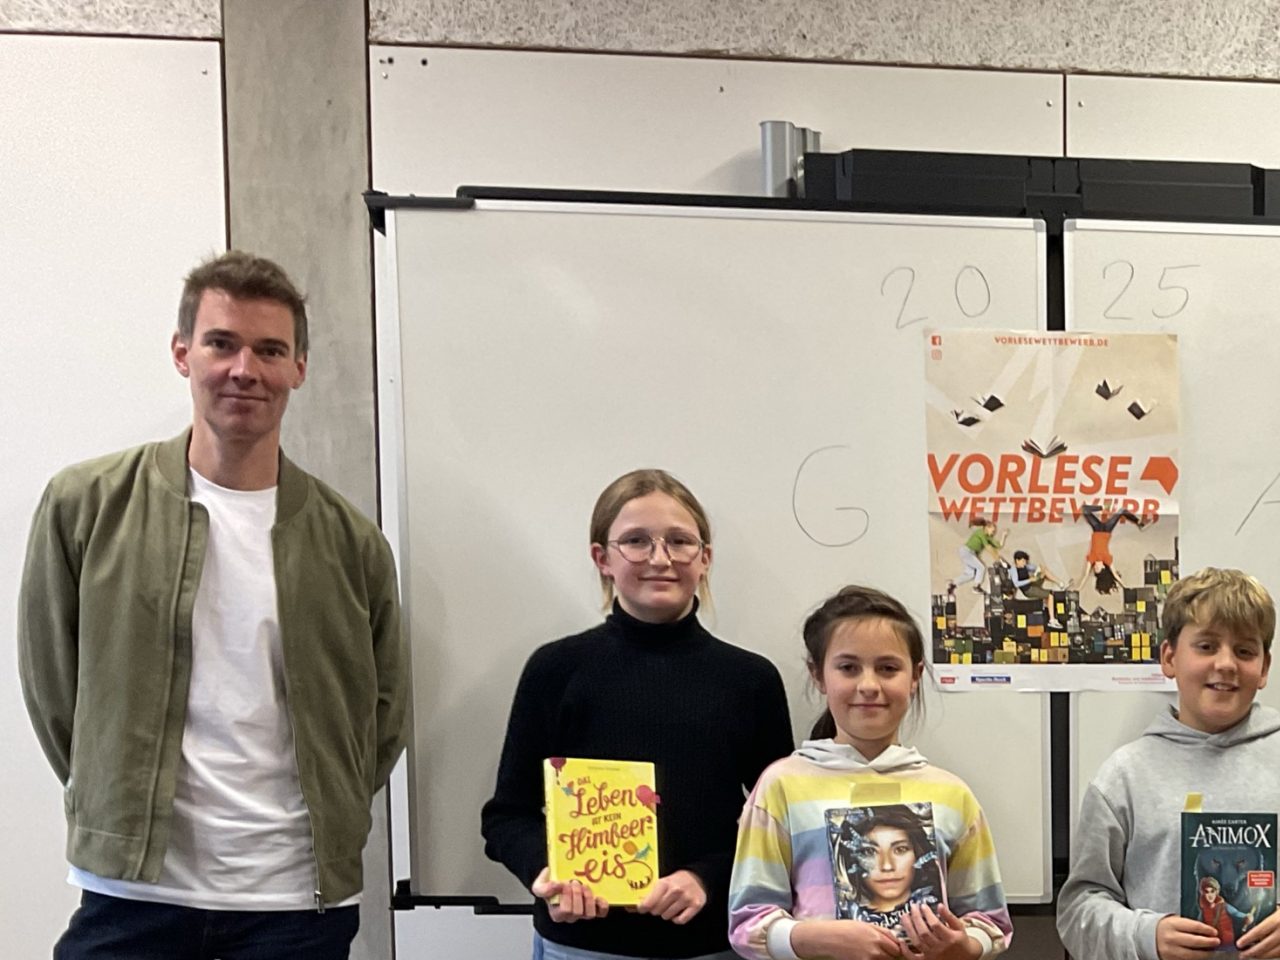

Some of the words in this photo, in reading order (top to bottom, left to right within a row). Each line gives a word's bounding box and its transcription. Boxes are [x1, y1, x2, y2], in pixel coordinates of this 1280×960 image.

[880, 264, 990, 329] 20
[1101, 259, 1200, 319] 25
[994, 336, 1109, 347] VORLESEWETTBEWERB.DE
[927, 453, 1132, 496] VORLESE
[792, 444, 869, 547] G
[937, 495, 1160, 524] WETTBEWERB
[570, 782, 637, 818] Leben
[574, 850, 627, 883] eis
